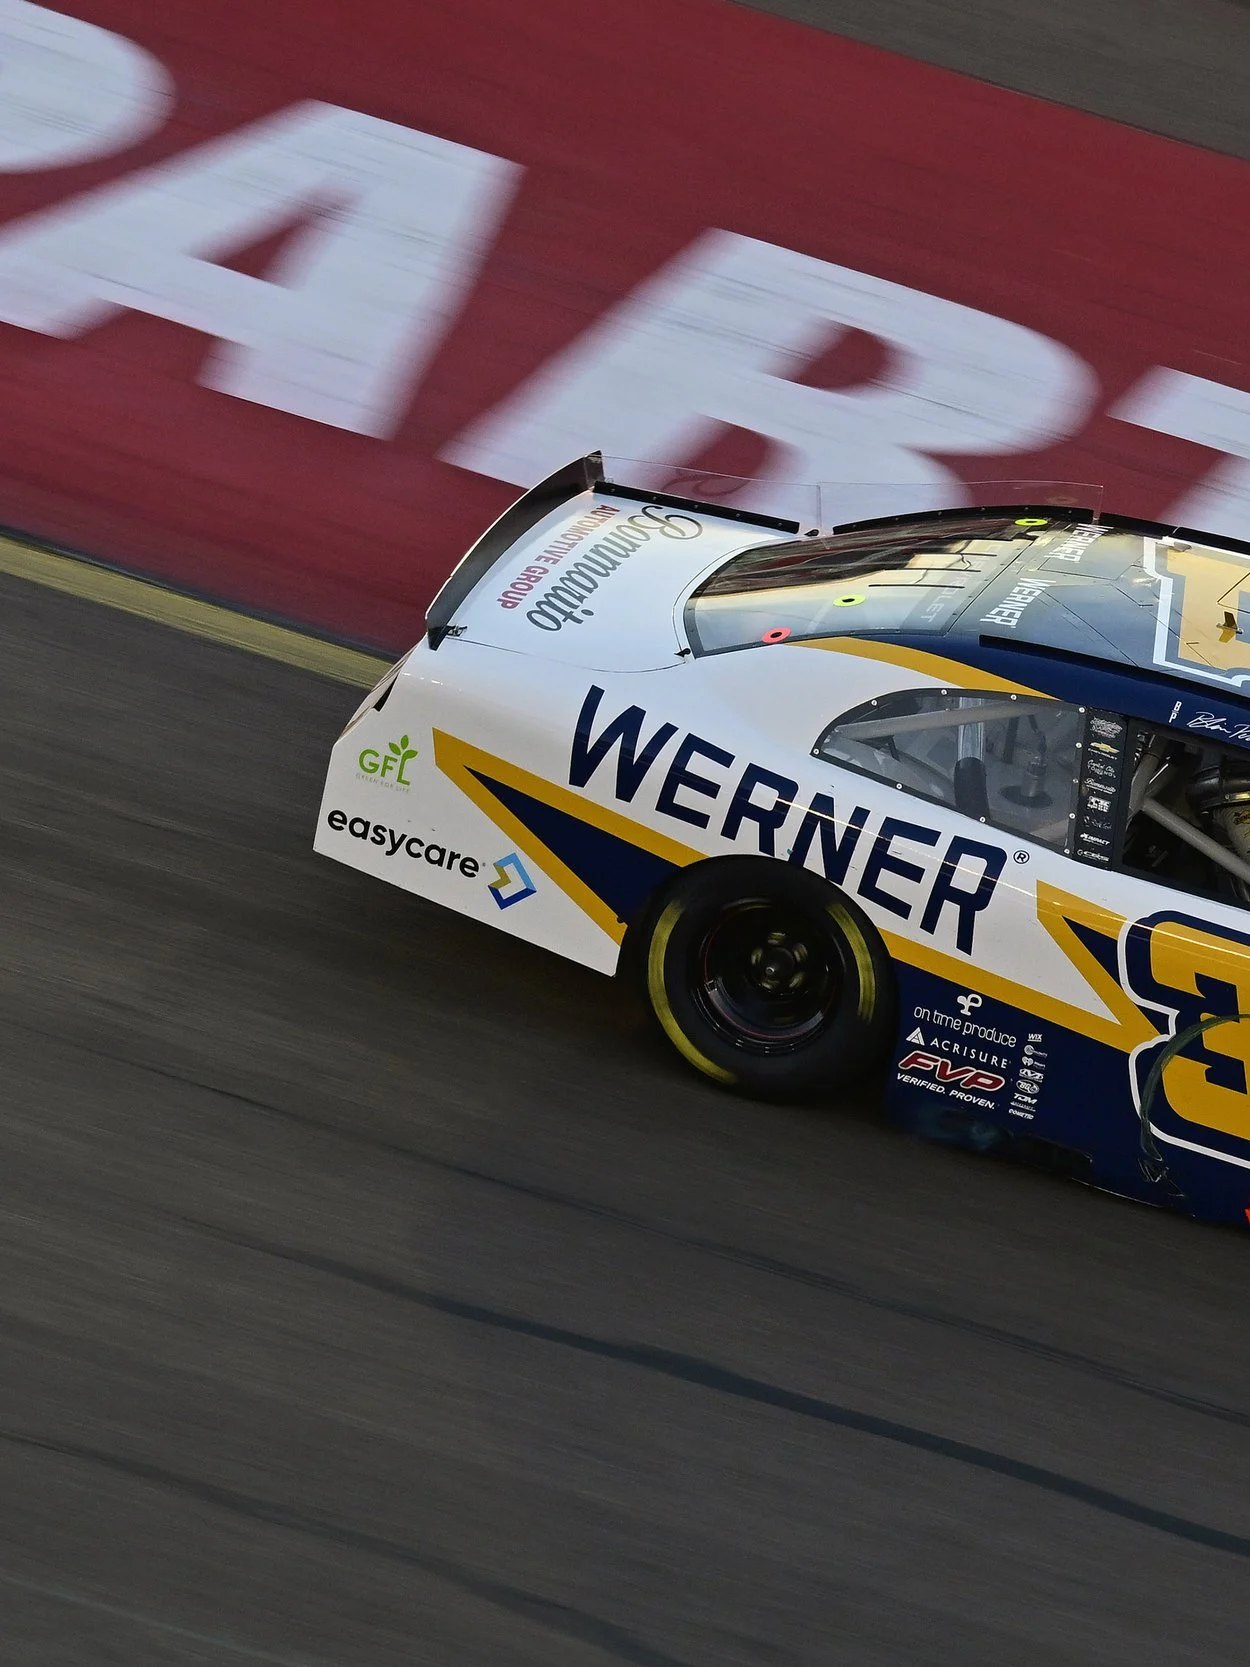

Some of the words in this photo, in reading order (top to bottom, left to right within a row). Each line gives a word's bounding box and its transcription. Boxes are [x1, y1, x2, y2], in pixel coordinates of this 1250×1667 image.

[534, 504, 621, 566] AUTOMOTIVE
[1044, 523, 1114, 562] WERNER
[497, 565, 550, 610] GROUP
[980, 577, 1056, 628] WERNER
[359, 742, 425, 786] GFL
[568, 684, 1007, 956] WERNER
[328, 809, 480, 878] easycare
[914, 1006, 931, 1022] on
[932, 1009, 962, 1031] time
[962, 1021, 1017, 1048] produce
[898, 1050, 1006, 1092] FVP
[930, 1037, 1008, 1069] ACRISURE
[896, 1072, 946, 1095] VERIFIED.
[949, 1089, 996, 1110] PROVEN.
